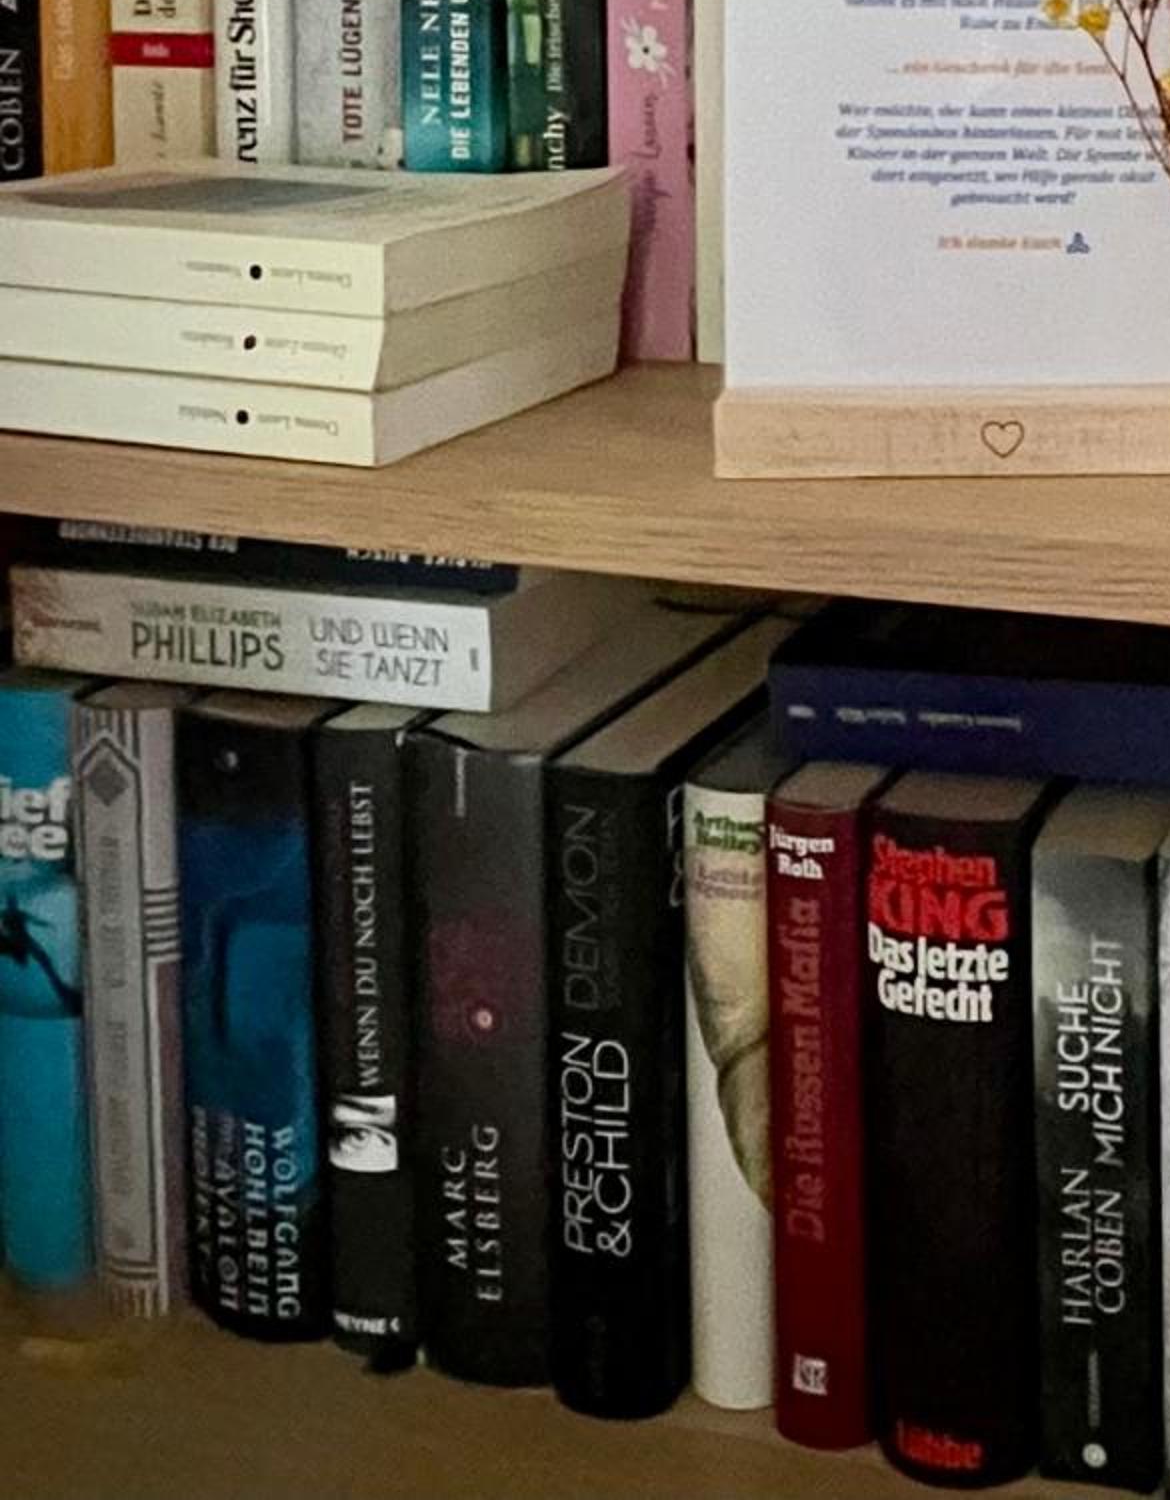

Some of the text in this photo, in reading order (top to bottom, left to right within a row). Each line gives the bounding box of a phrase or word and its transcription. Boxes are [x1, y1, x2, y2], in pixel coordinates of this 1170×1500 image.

[227, 47, 257, 95] für
[421, 60, 442, 127] NELE
[448, 12, 471, 119] LEBENDEN
[1, 47, 25, 173] COBEN
[342, 86, 364, 143] TOTE
[450, 122, 470, 160] DIE
[130, 621, 287, 671] PHILLIPS
[308, 614, 365, 646] UND
[315, 648, 445, 688] SIE TANZT
[768, 822, 836, 856] Jürgen
[777, 853, 825, 882] Roth
[871, 833, 997, 887] Stephen
[348, 779, 383, 1089] WENN DU NOCH LEBST
[562, 803, 600, 1011] DEMON
[866, 875, 1011, 942] KING
[866, 919, 1010, 983] Das letzte
[876, 970, 996, 1024] Gefecht
[1057, 980, 1090, 1114] SUCHE
[1089, 935, 1126, 1169] MICH NICHT
[561, 1030, 595, 1255] PRESTON
[244, 1121, 270, 1318] HOHLBEIN
[271, 1124, 301, 1320] WOLFGANG
[442, 1145, 468, 1270] MARC
[470, 1122, 503, 1304] ELSBERG
[785, 1175, 826, 1244] Die
[1060, 1166, 1097, 1326] HARLAN
[1093, 1189, 1127, 1316] COBEN
